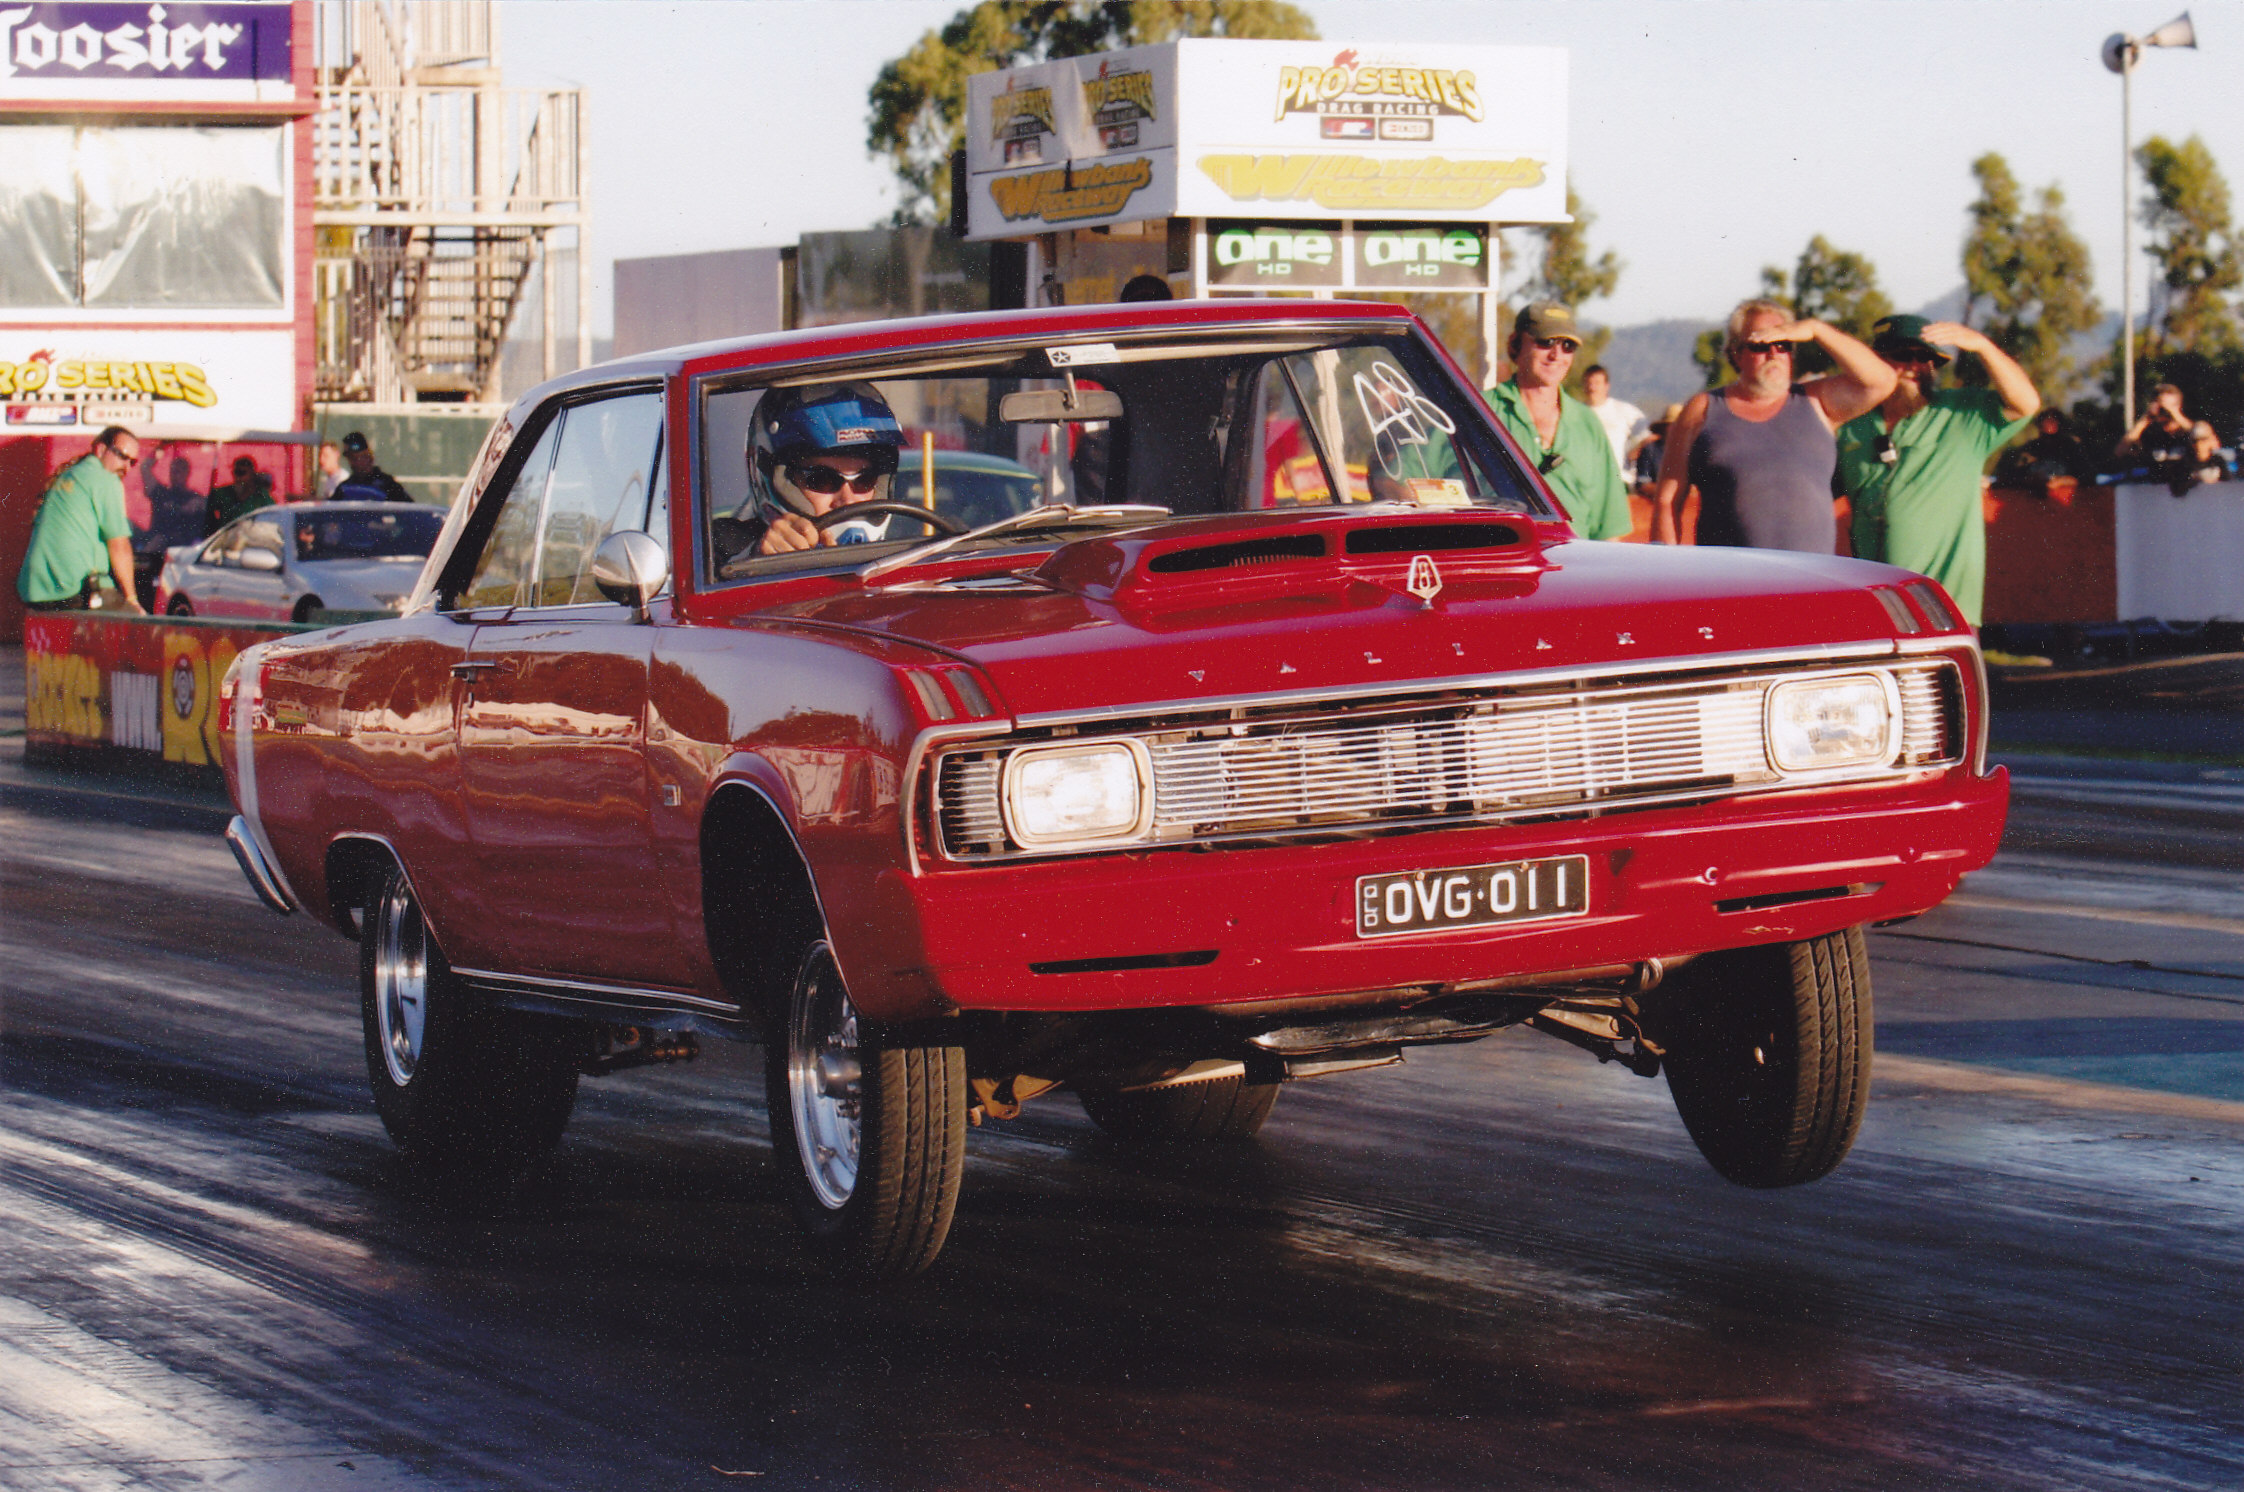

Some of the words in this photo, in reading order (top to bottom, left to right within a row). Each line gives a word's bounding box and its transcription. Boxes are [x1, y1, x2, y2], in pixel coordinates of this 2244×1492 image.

[1274, 66, 1349, 123] PRO
[1354, 67, 1485, 123] SERIES
[1316, 102, 1363, 114] DRAG
[1373, 103, 1439, 116] RACING
[1215, 229, 1333, 266] one
[1364, 230, 1481, 267] one
[1257, 263, 1291, 275] HD
[1405, 264, 1440, 276] HD
[57, 361, 218, 407] SERIES
